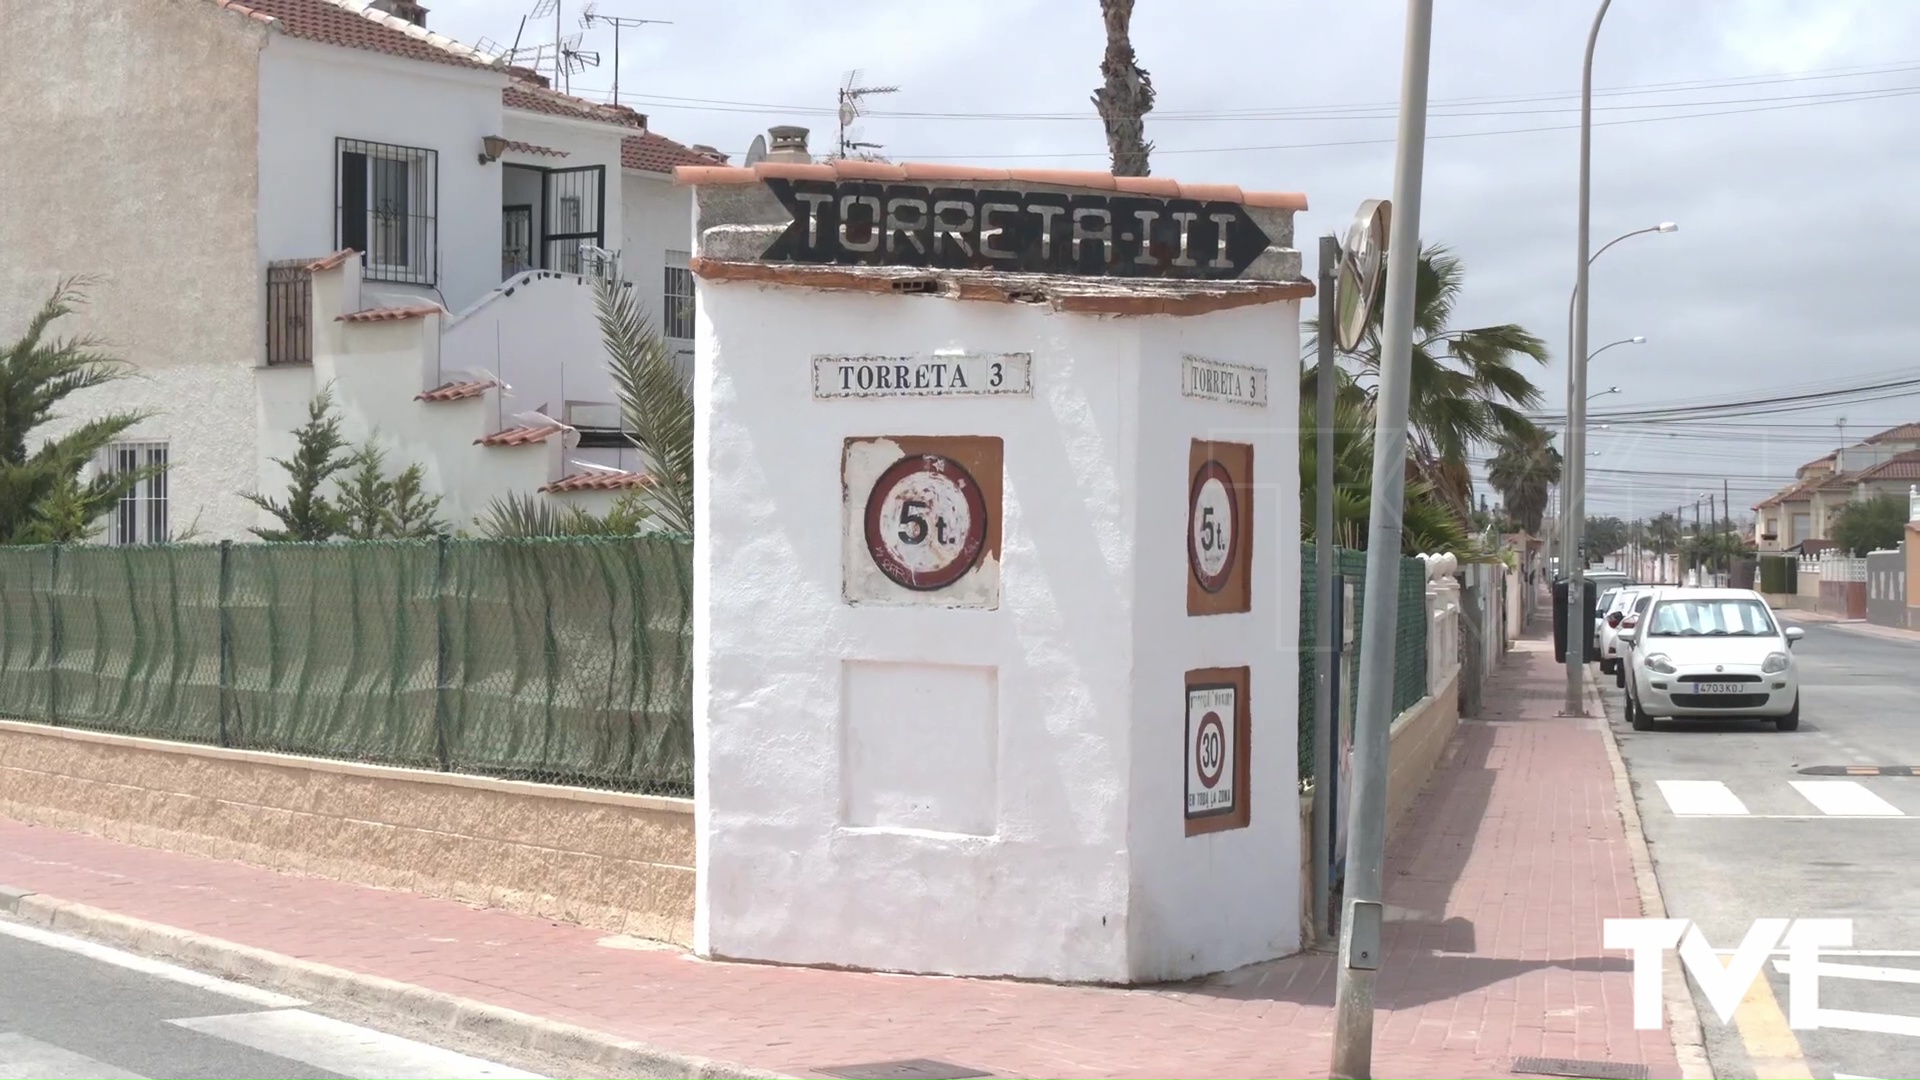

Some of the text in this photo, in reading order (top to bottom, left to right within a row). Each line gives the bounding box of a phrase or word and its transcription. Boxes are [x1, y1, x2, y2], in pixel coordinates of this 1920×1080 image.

[838, 362, 1004, 390] TORRETA 3
[1191, 366, 1256, 398] TORRETA 3
[1202, 731, 1219, 769] 30
[1218, 789, 1231, 803] ZONA
